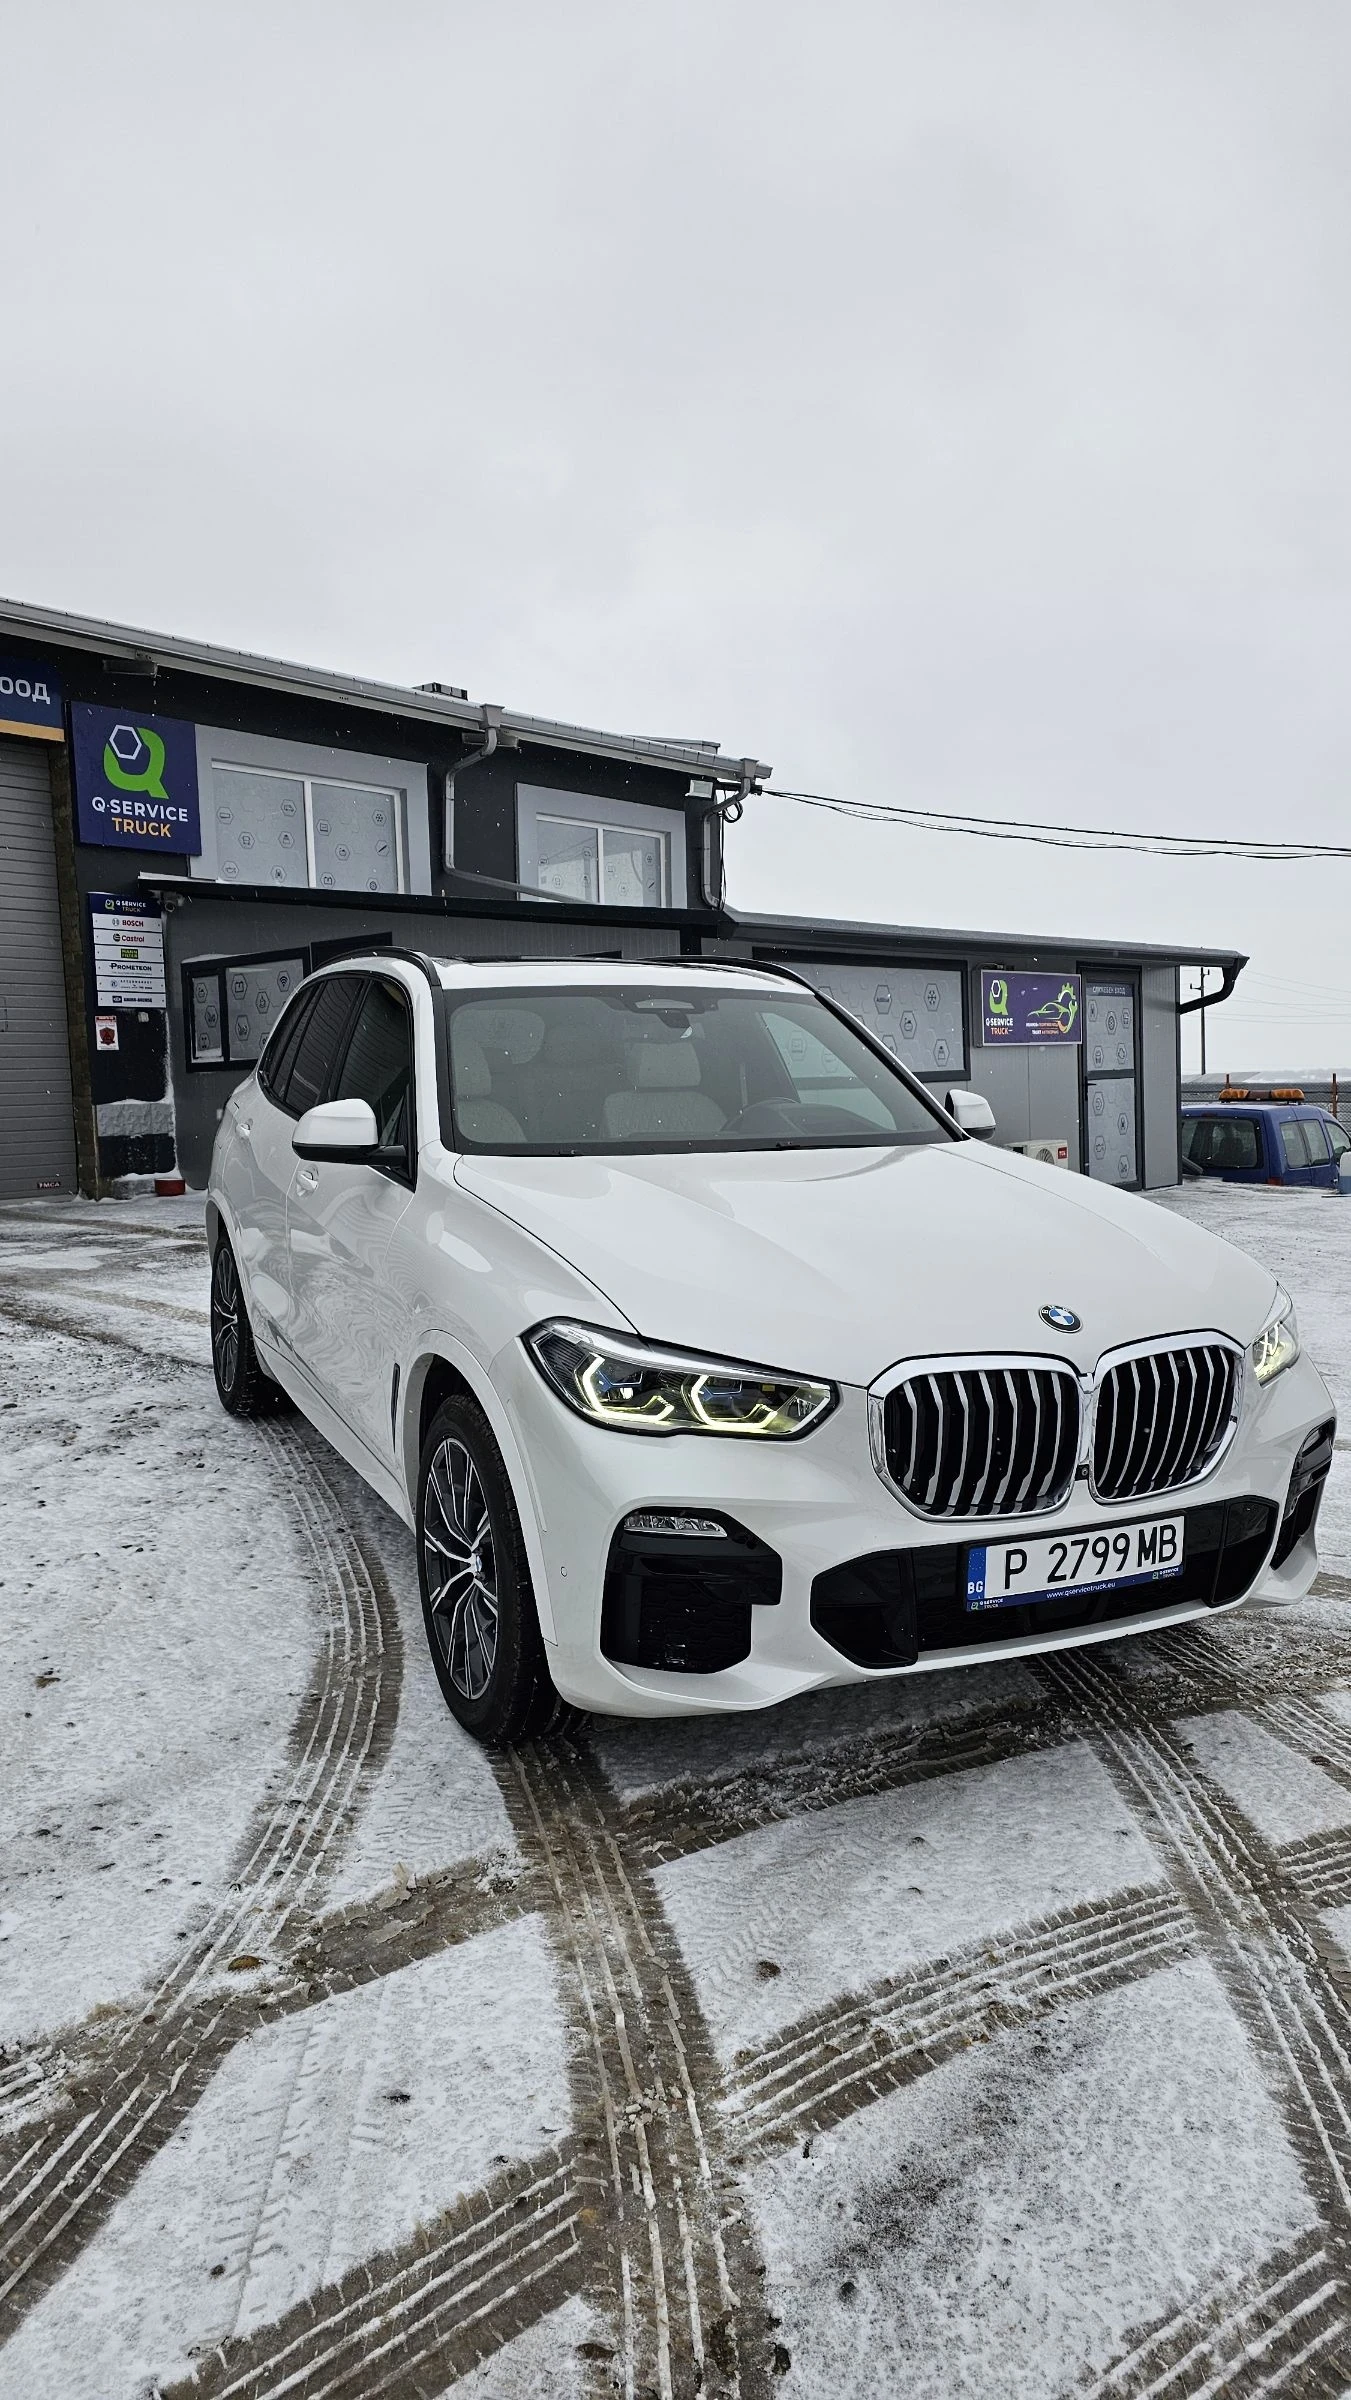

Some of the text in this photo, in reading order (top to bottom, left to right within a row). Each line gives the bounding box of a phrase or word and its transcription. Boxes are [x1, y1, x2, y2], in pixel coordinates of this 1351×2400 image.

[0, 676, 51, 705] ООД
[111, 817, 172, 838] TRUCK
[122, 919, 144, 928] BOSCH
[121, 935, 145, 943] Castrol
[990, 1027, 1009, 1035] TRUCK
[1004, 1523, 1177, 1590] P 2799 MB
[967, 1580, 984, 1594] BG
[1046, 1582, 1116, 1599] www.qservicetruck.eu
